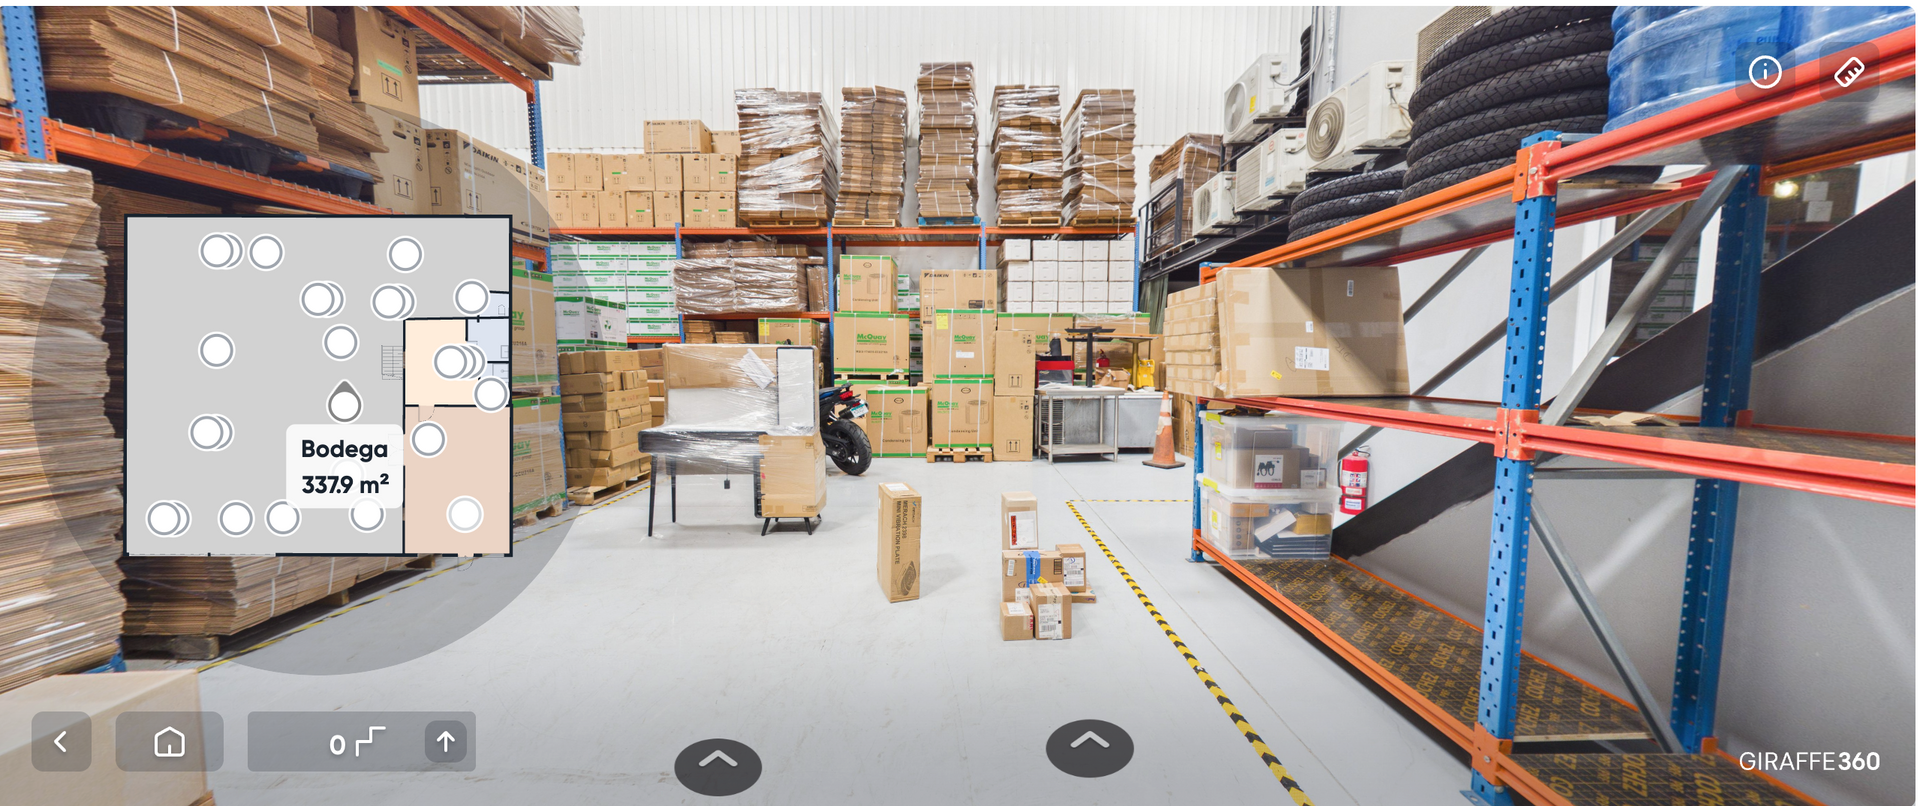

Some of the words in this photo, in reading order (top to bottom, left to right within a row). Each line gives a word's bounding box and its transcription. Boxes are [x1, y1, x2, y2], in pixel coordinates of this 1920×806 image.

[1372, 600, 1396, 619] COCHEZ
[1350, 621, 1378, 643] COCHEZ
[1388, 631, 1415, 656] COCHEZ
[1430, 642, 1456, 669] COCHEZ
[1416, 671, 1440, 698] OCHEZ
[1525, 668, 1548, 699] COCHEZ
[1516, 703, 1541, 735] OCHEZ
[1622, 754, 1649, 797] OCHEZ
